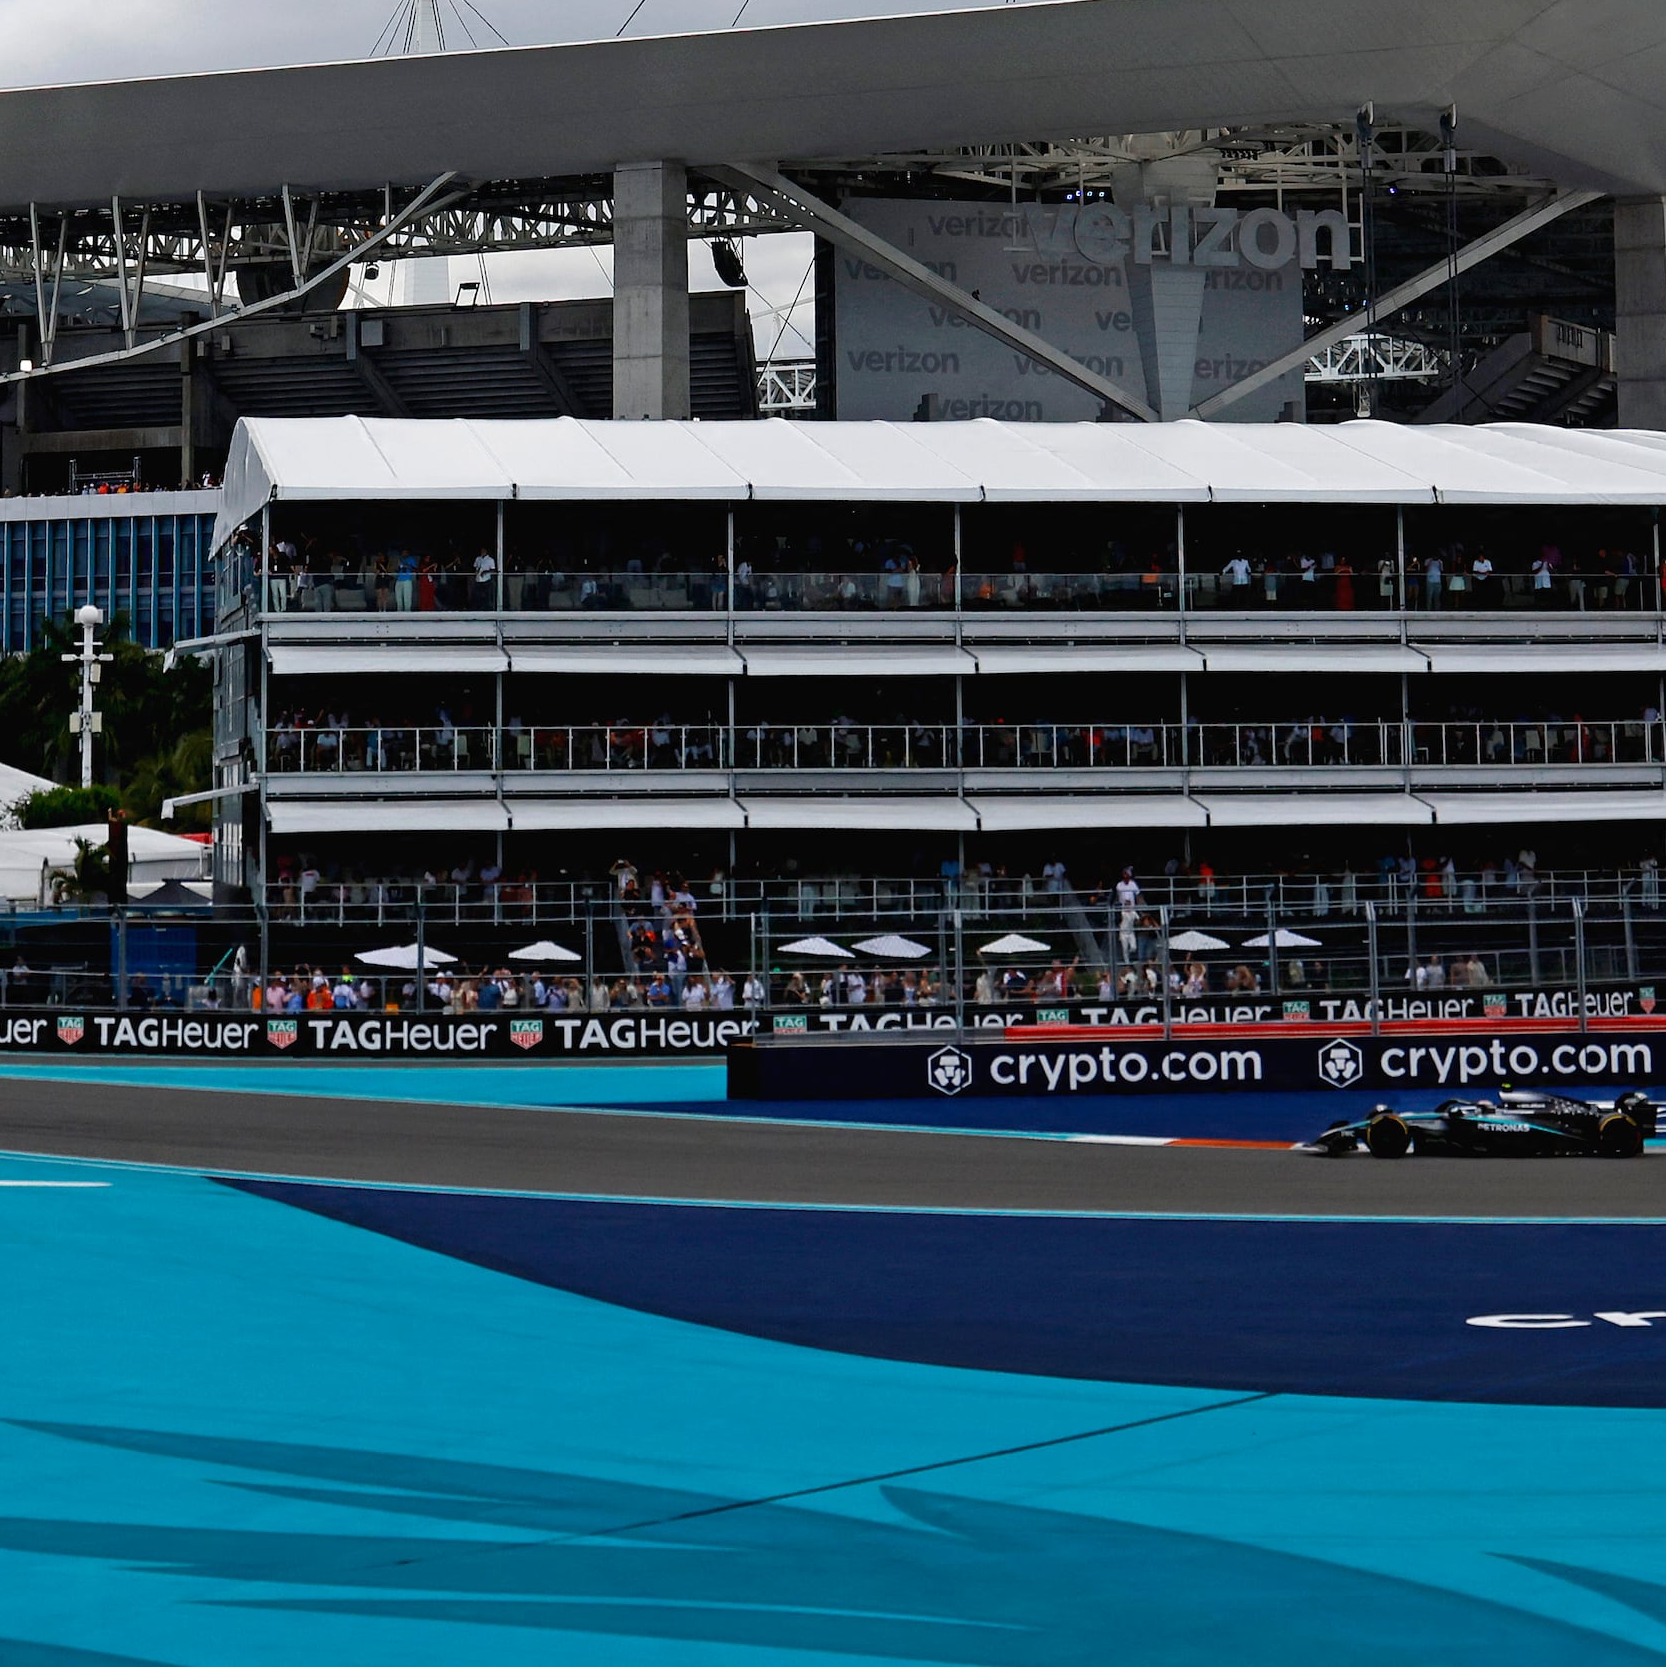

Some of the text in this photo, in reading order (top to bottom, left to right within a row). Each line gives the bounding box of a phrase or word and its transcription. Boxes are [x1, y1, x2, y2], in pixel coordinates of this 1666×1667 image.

[1023, 202, 1351, 270] verizon
[1011, 258, 1122, 286] verizon
[847, 345, 960, 374] verizon
[1040, 1010, 1067, 1021] TAG
[1286, 1002, 1309, 1012] TAG
[59, 1017, 83, 1028] TAG
[94, 1017, 259, 1049] TAGHeuer
[268, 1021, 296, 1031] TAG
[307, 1020, 497, 1050] TAGHeuer
[512, 1021, 541, 1032] TAG
[777, 1016, 805, 1028] TAG
[990, 1046, 1262, 1091] crypto.com
[1380, 1038, 1652, 1084] crypto.com
